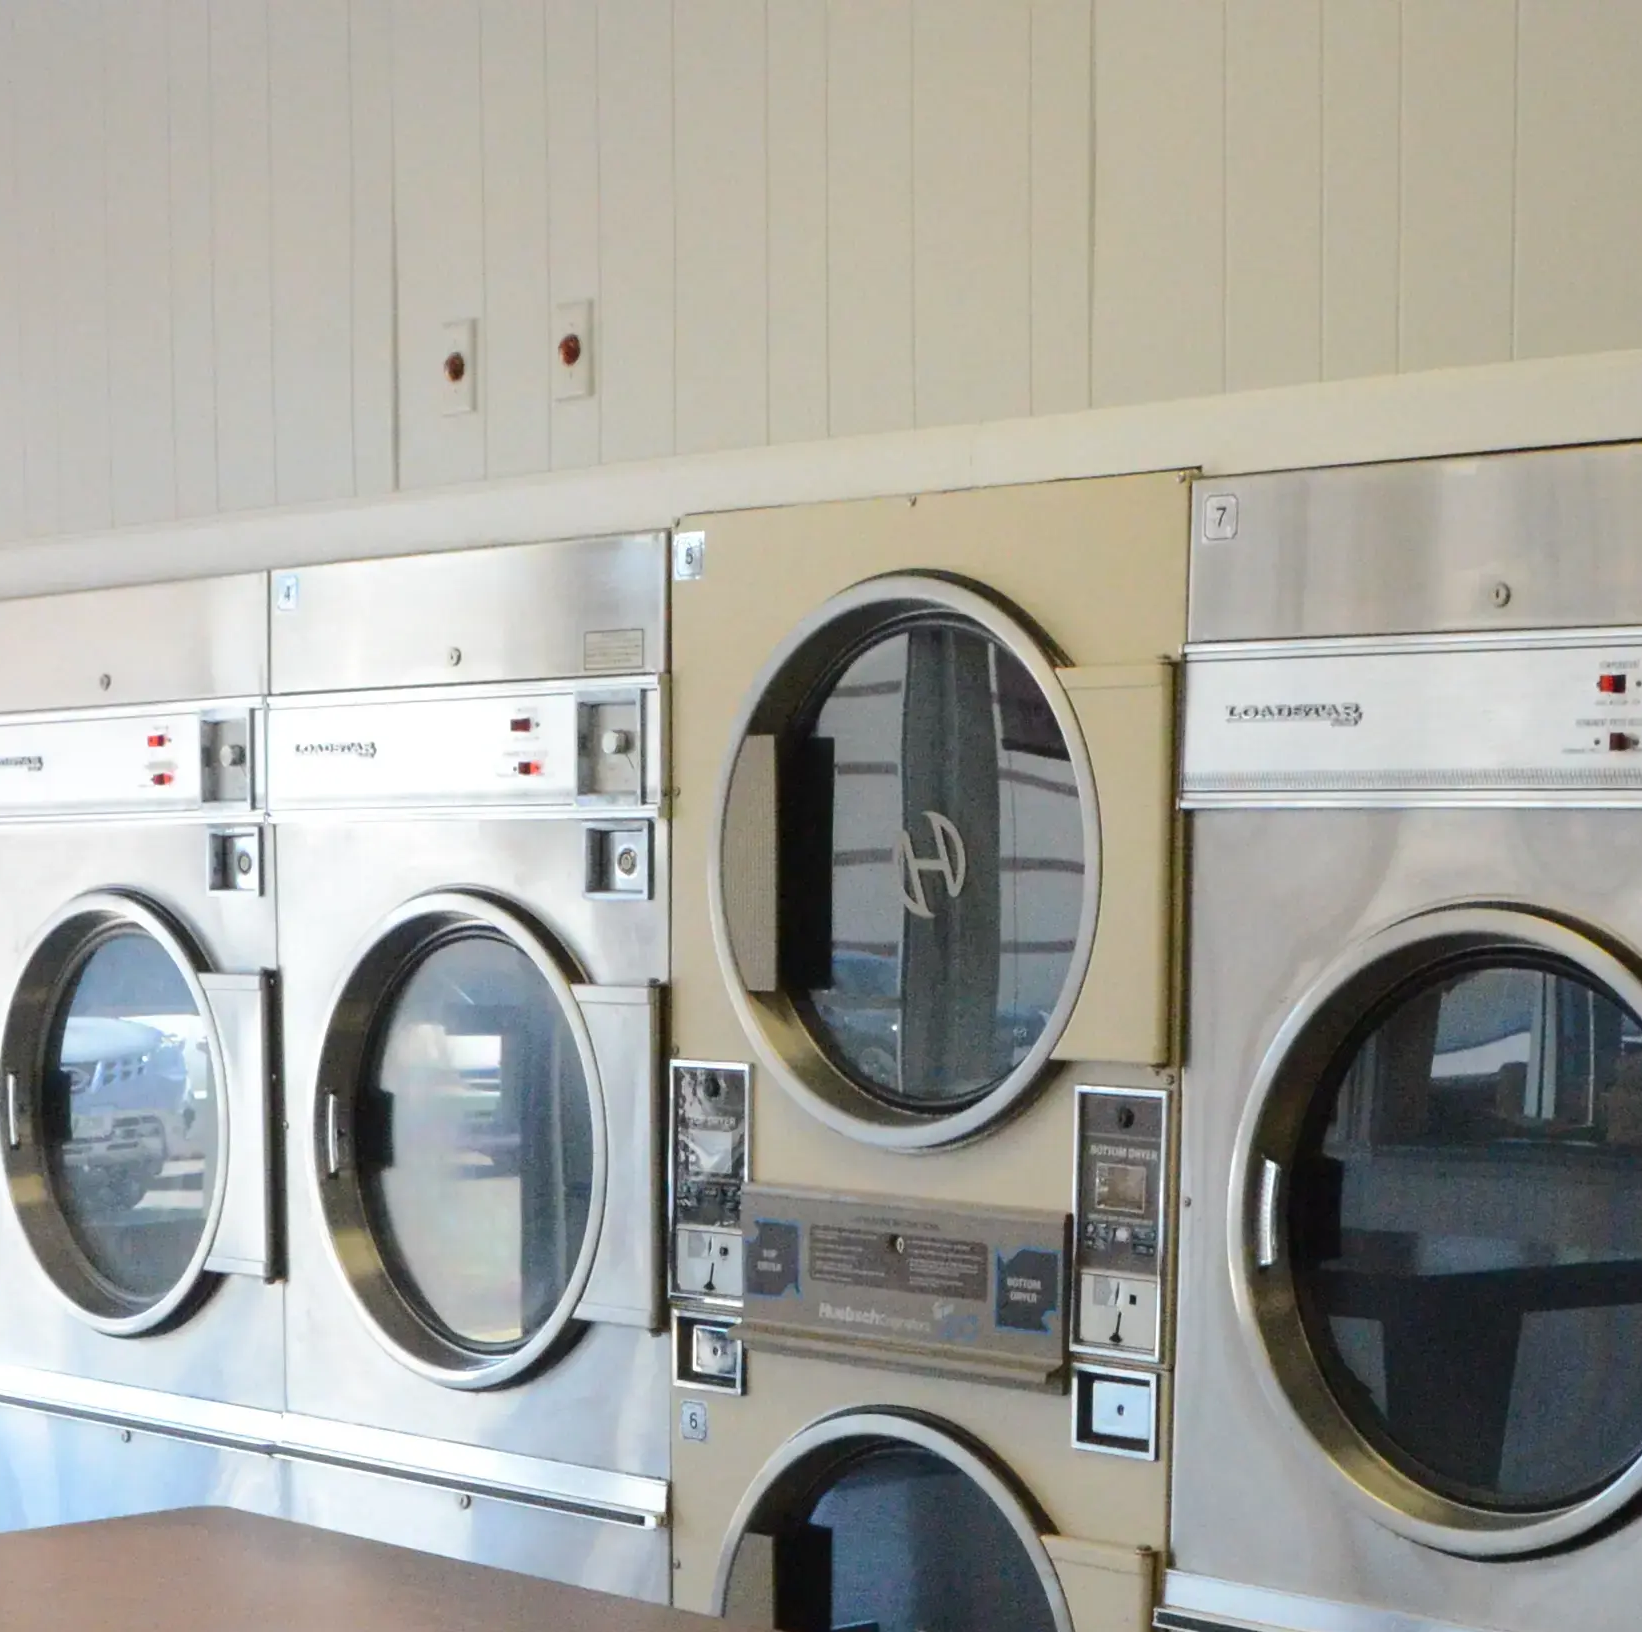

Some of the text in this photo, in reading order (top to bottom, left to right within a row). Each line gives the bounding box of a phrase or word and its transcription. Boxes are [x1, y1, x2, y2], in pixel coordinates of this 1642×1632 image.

[1215, 506, 1227, 528] 7
[1089, 1144, 1158, 1161] BOTTOM DRYER
[1007, 1278, 1042, 1290] BOTTOM
[818, 1302, 880, 1325] Huebsch
[688, 1411, 698, 1430] 6
